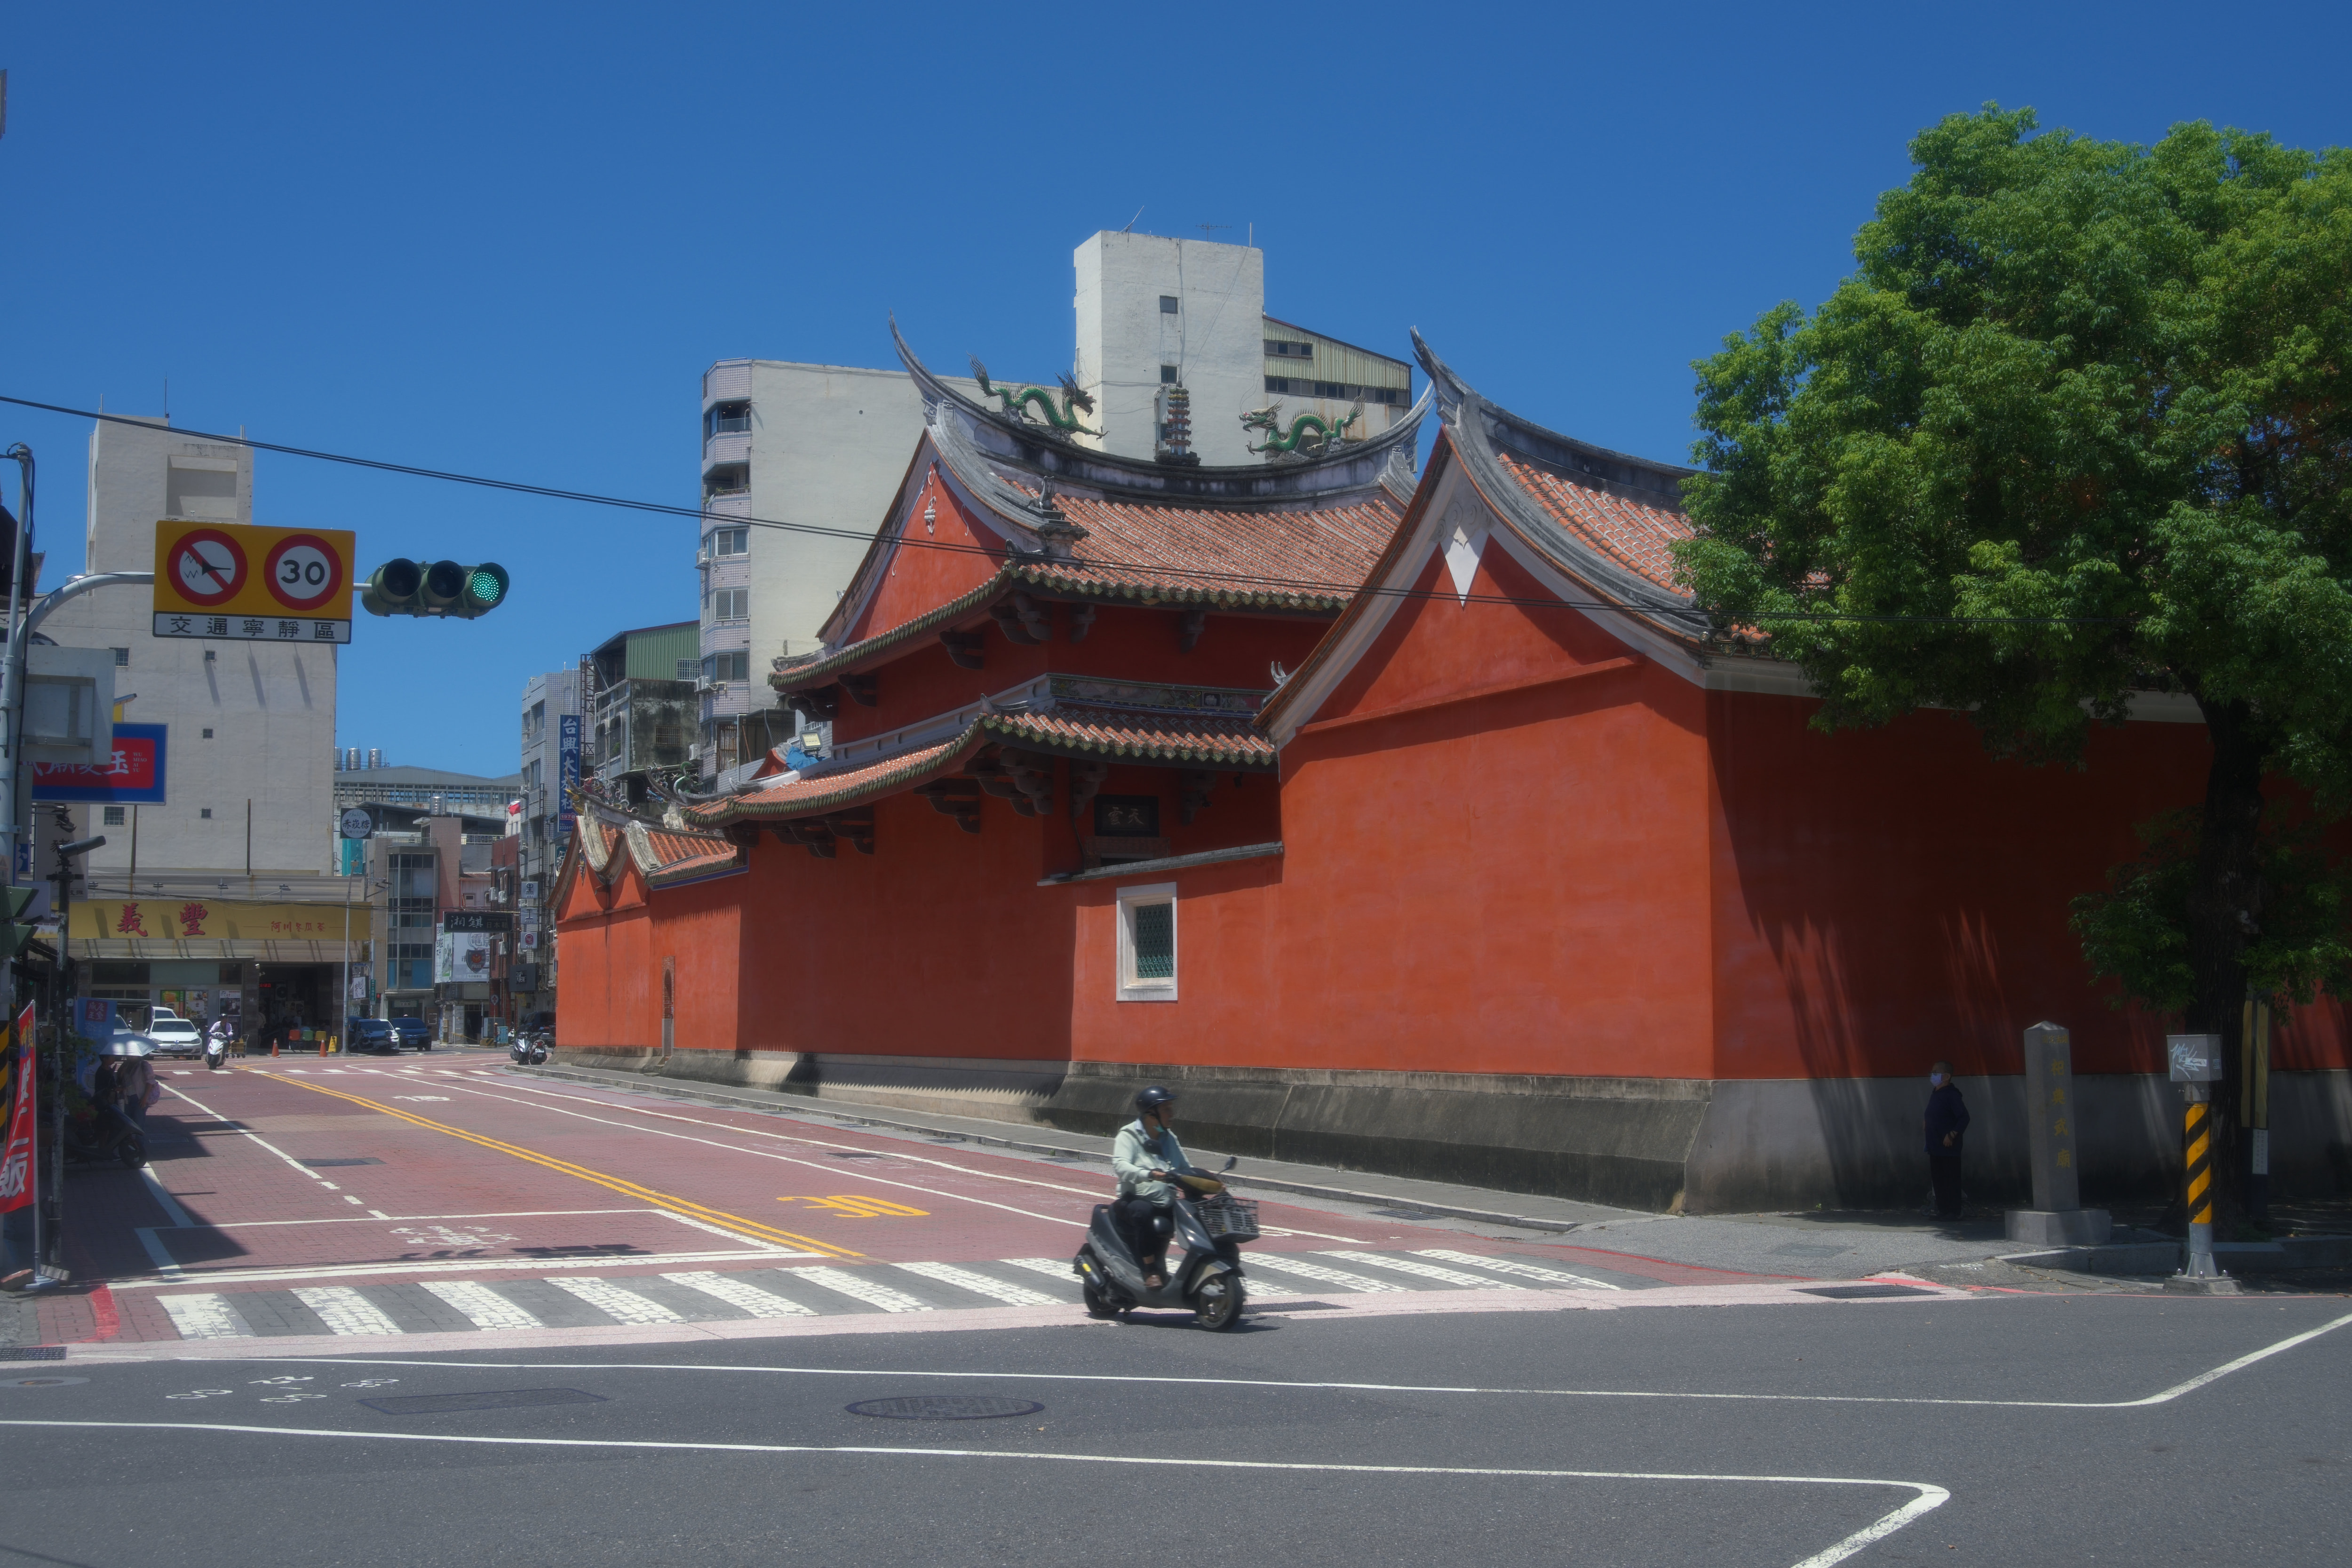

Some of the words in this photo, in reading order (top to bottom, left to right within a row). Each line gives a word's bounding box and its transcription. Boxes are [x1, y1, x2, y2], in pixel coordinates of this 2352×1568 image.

[280, 559, 325, 586] 30
[170, 616, 335, 640] 交通寧靜區
[342, 819, 370, 829] 赤崁糖
[117, 902, 208, 937] 義豐
[270, 921, 326, 933] 阿川冬瓜茶
[2050, 1059, 2071, 1168] 祀典武廟
[776, 1195, 931, 1218] 30
